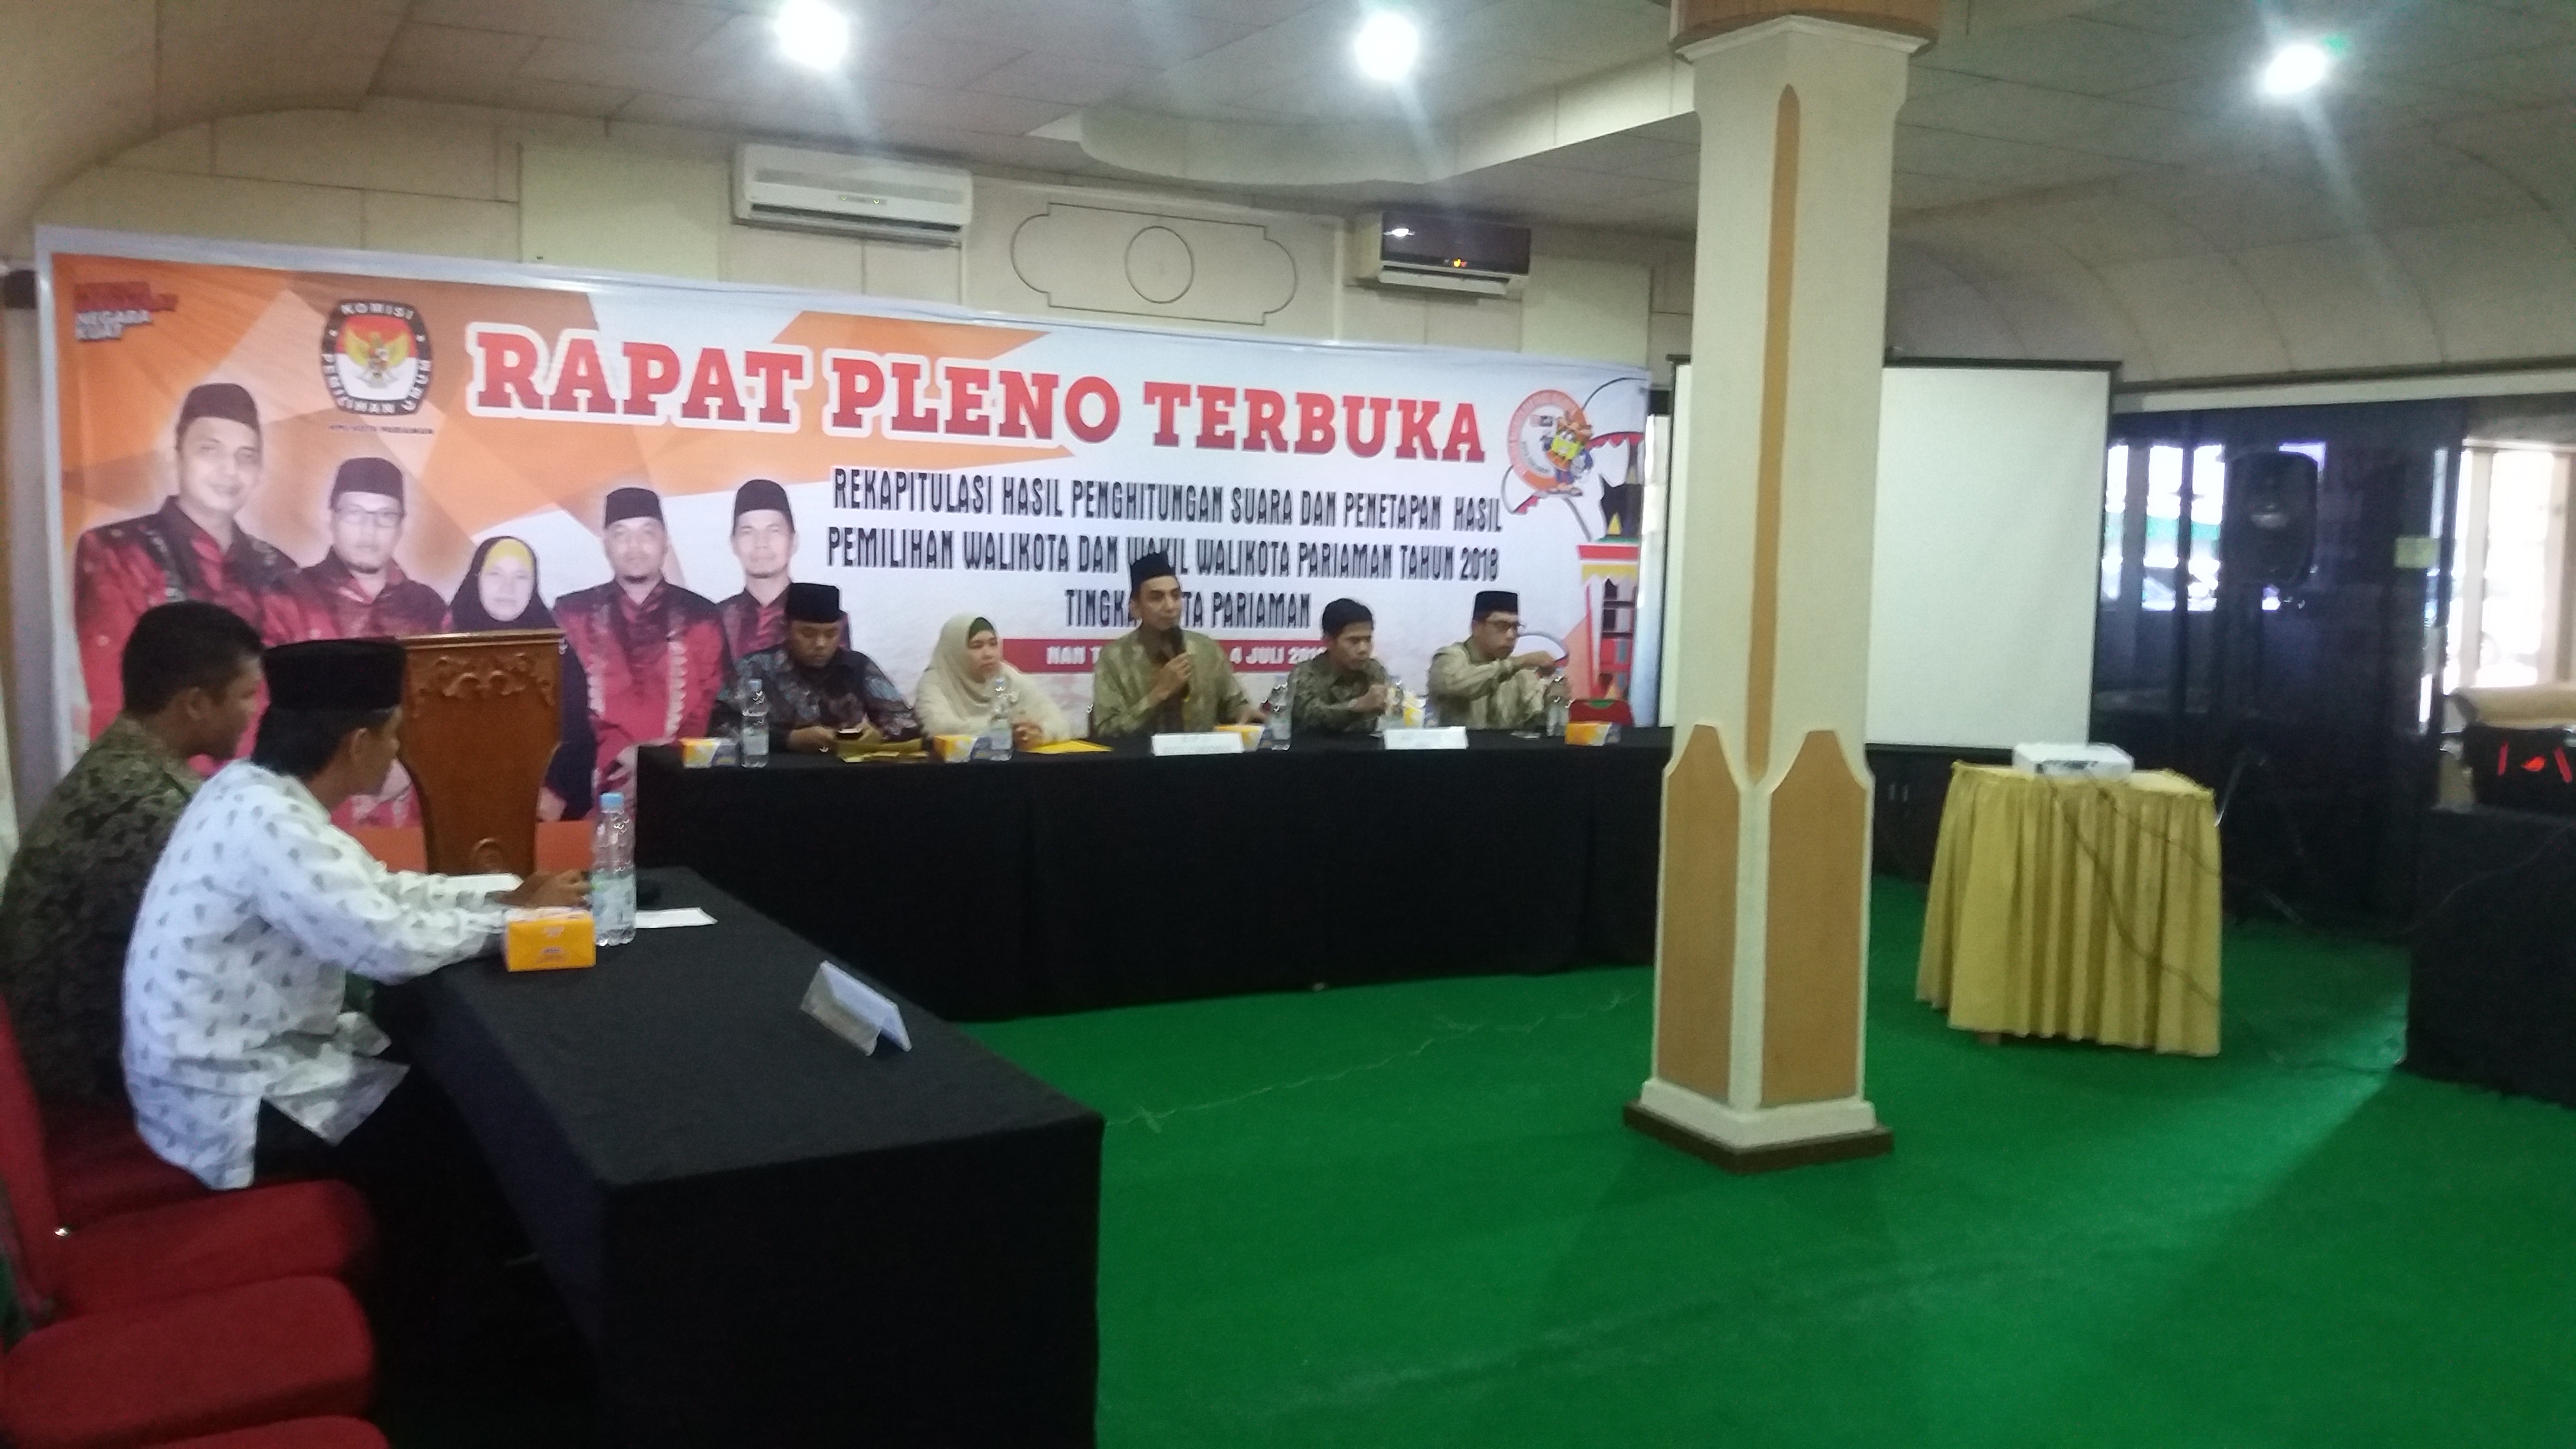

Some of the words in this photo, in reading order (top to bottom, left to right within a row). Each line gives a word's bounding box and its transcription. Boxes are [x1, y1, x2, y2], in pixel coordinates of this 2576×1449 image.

[341, 302, 413, 320] KOMISI
[476, 331, 805, 425] RAPAT
[831, 357, 1121, 443] PLENO
[1143, 381, 1486, 463] TERBUKA
[834, 468, 993, 514] REKAPITULASI
[1002, 476, 1063, 517] HASIL
[1071, 480, 1224, 524] PENGHITUNGAN
[1231, 487, 1292, 525] SUARA
[1300, 490, 1337, 527] DAN
[1344, 492, 1442, 530] PENETAPAN
[1453, 496, 1503, 533] HASIL
[827, 526, 954, 569] PEMILIHAN
[964, 530, 1070, 572] WALIKOTA
[1078, 535, 1119, 573] DAN
[1196, 538, 1290, 578] WALIKOTA
[1297, 542, 1393, 579] PARIAMAN
[1400, 544, 1454, 580] TAHUN
[1460, 547, 1499, 582] 2018
[1066, 590, 1138, 627] TINGK
[1211, 592, 1310, 628] PARIAMAN
[1230, 646, 1242, 664] 4
[1246, 646, 1284, 665] JULI
